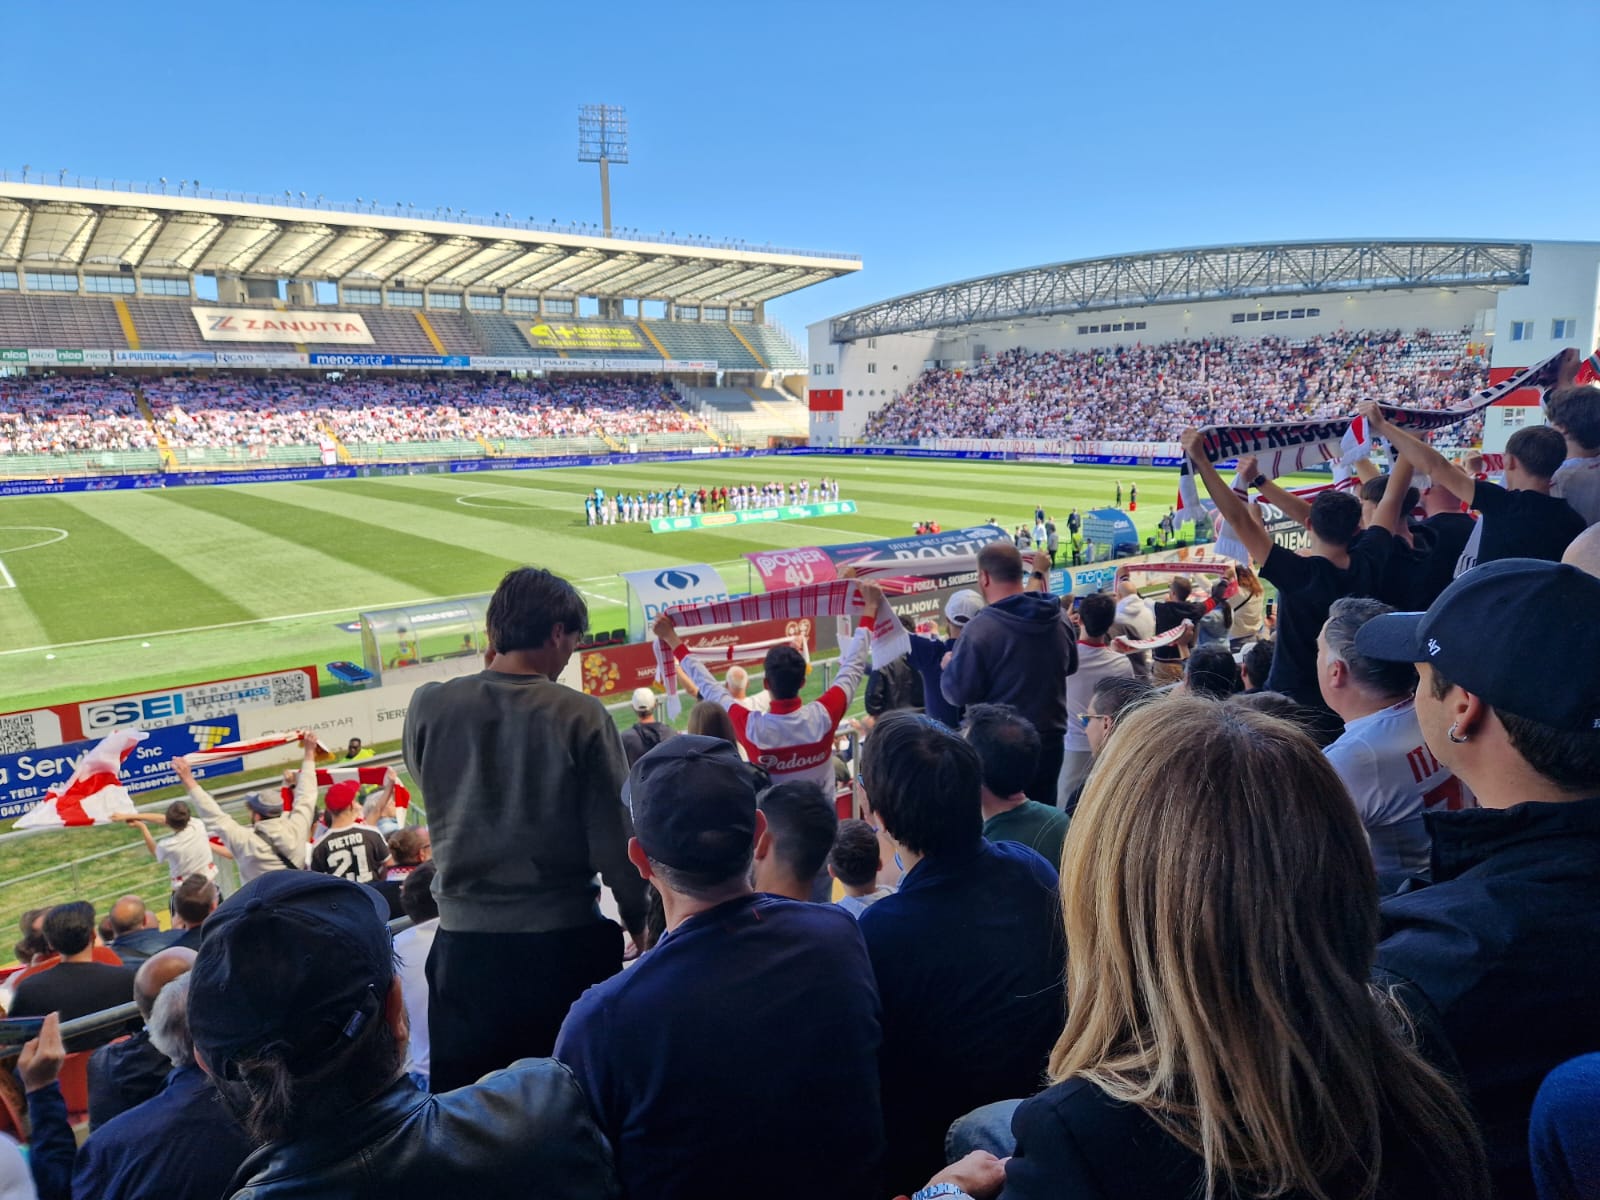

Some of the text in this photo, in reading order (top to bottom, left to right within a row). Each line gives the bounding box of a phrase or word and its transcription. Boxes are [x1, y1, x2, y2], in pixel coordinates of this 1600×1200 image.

[243, 319, 361, 333] ZANUTTA
[2, 350, 27, 359] nico
[31, 351, 54, 360] nico
[58, 351, 82, 360] nico
[86, 352, 108, 360] nico
[184, 472, 308, 485] WWW.NONSOLOSPORT.IT
[0, 484, 65, 494] OSPORT.IT
[756, 550, 825, 576] POWER
[785, 564, 814, 586] 4U
[948, 571, 979, 586] SICUREZZ
[890, 599, 939, 616] TALNOVA
[185, 679, 270, 697] SERVIZIO
[186, 686, 271, 707] ENERGETICO
[186, 694, 271, 714] ITALIANO
[204, 707, 236, 720] GAS
[17, 748, 90, 781] Serv
[136, 746, 163, 759] Snc
[143, 760, 174, 774] CART
[757, 751, 826, 770] Padova
[9, 786, 38, 801] TESI
[327, 832, 363, 851] PIETRO
[326, 844, 374, 883] 21
